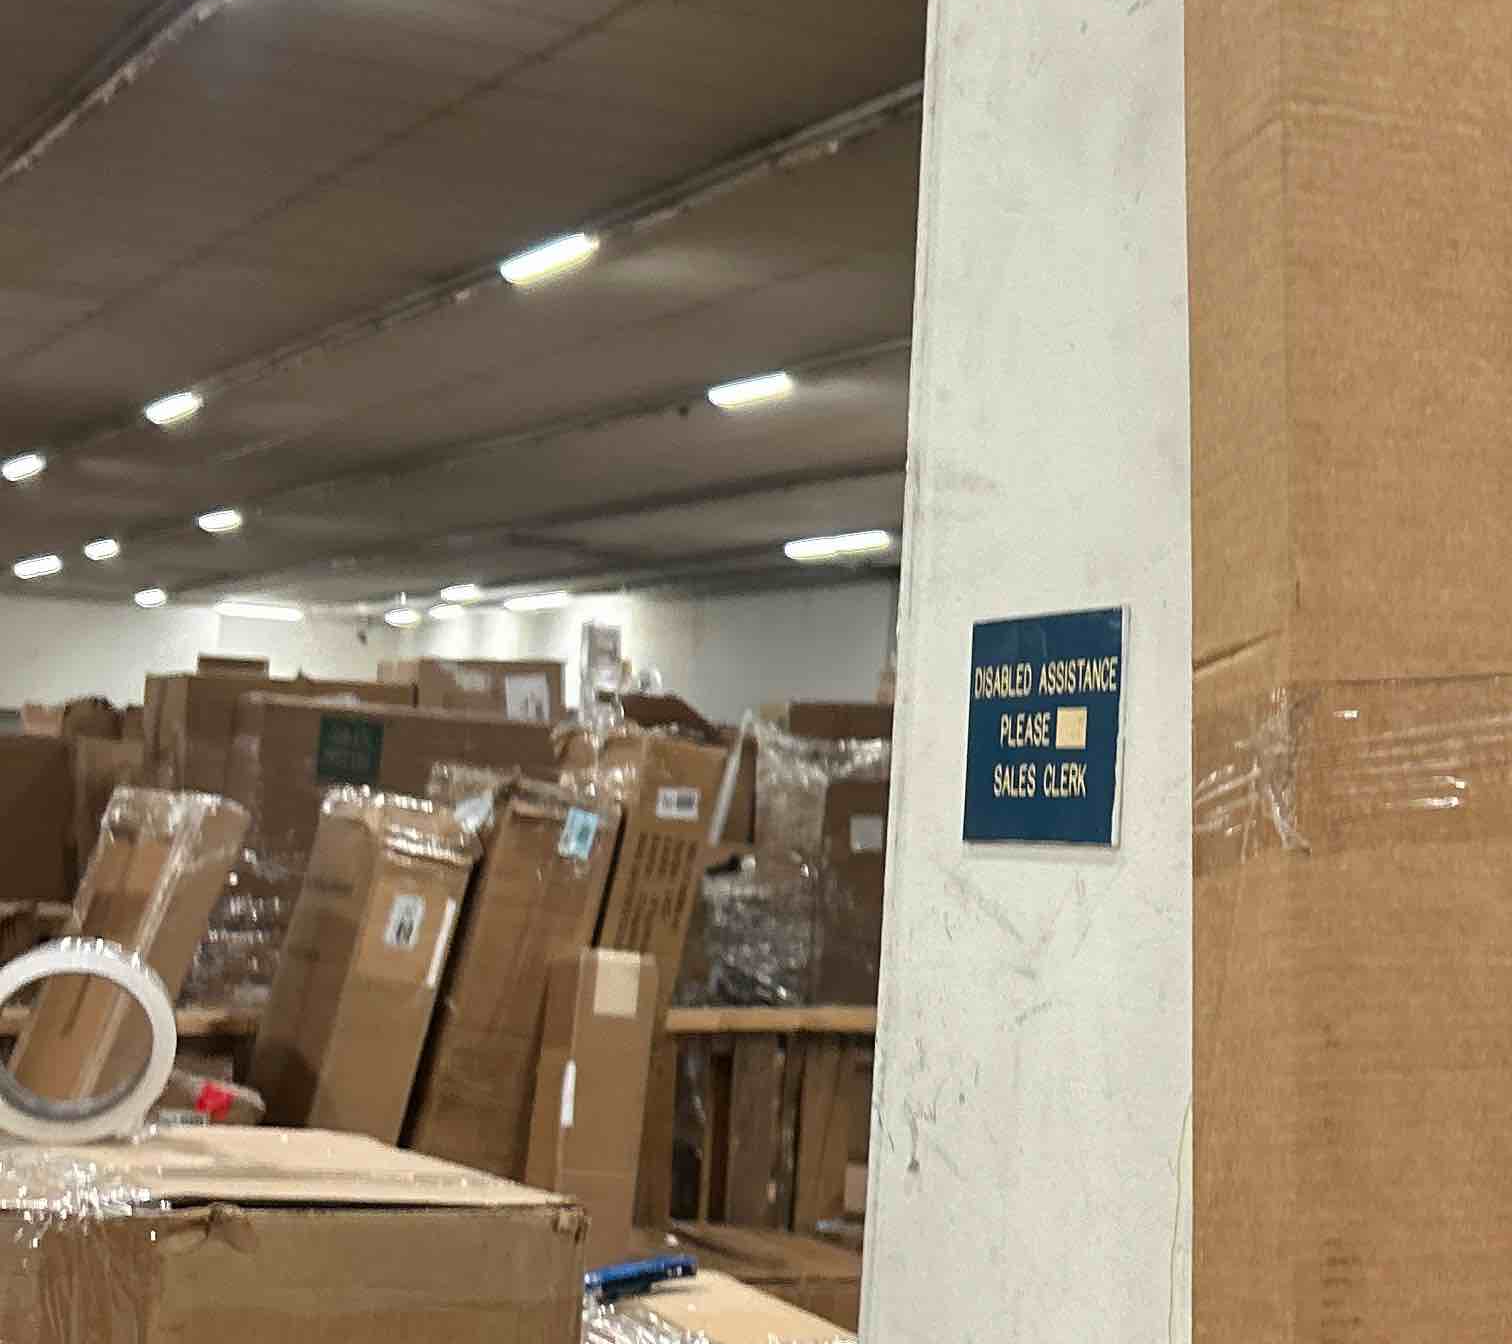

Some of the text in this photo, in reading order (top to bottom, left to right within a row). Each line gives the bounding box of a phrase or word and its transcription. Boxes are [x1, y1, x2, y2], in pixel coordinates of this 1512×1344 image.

[975, 657, 1118, 699] DISABLED ASSISTANCE
[1000, 712, 1050, 747] PLEASE
[993, 763, 1087, 797] SALES CLERK
